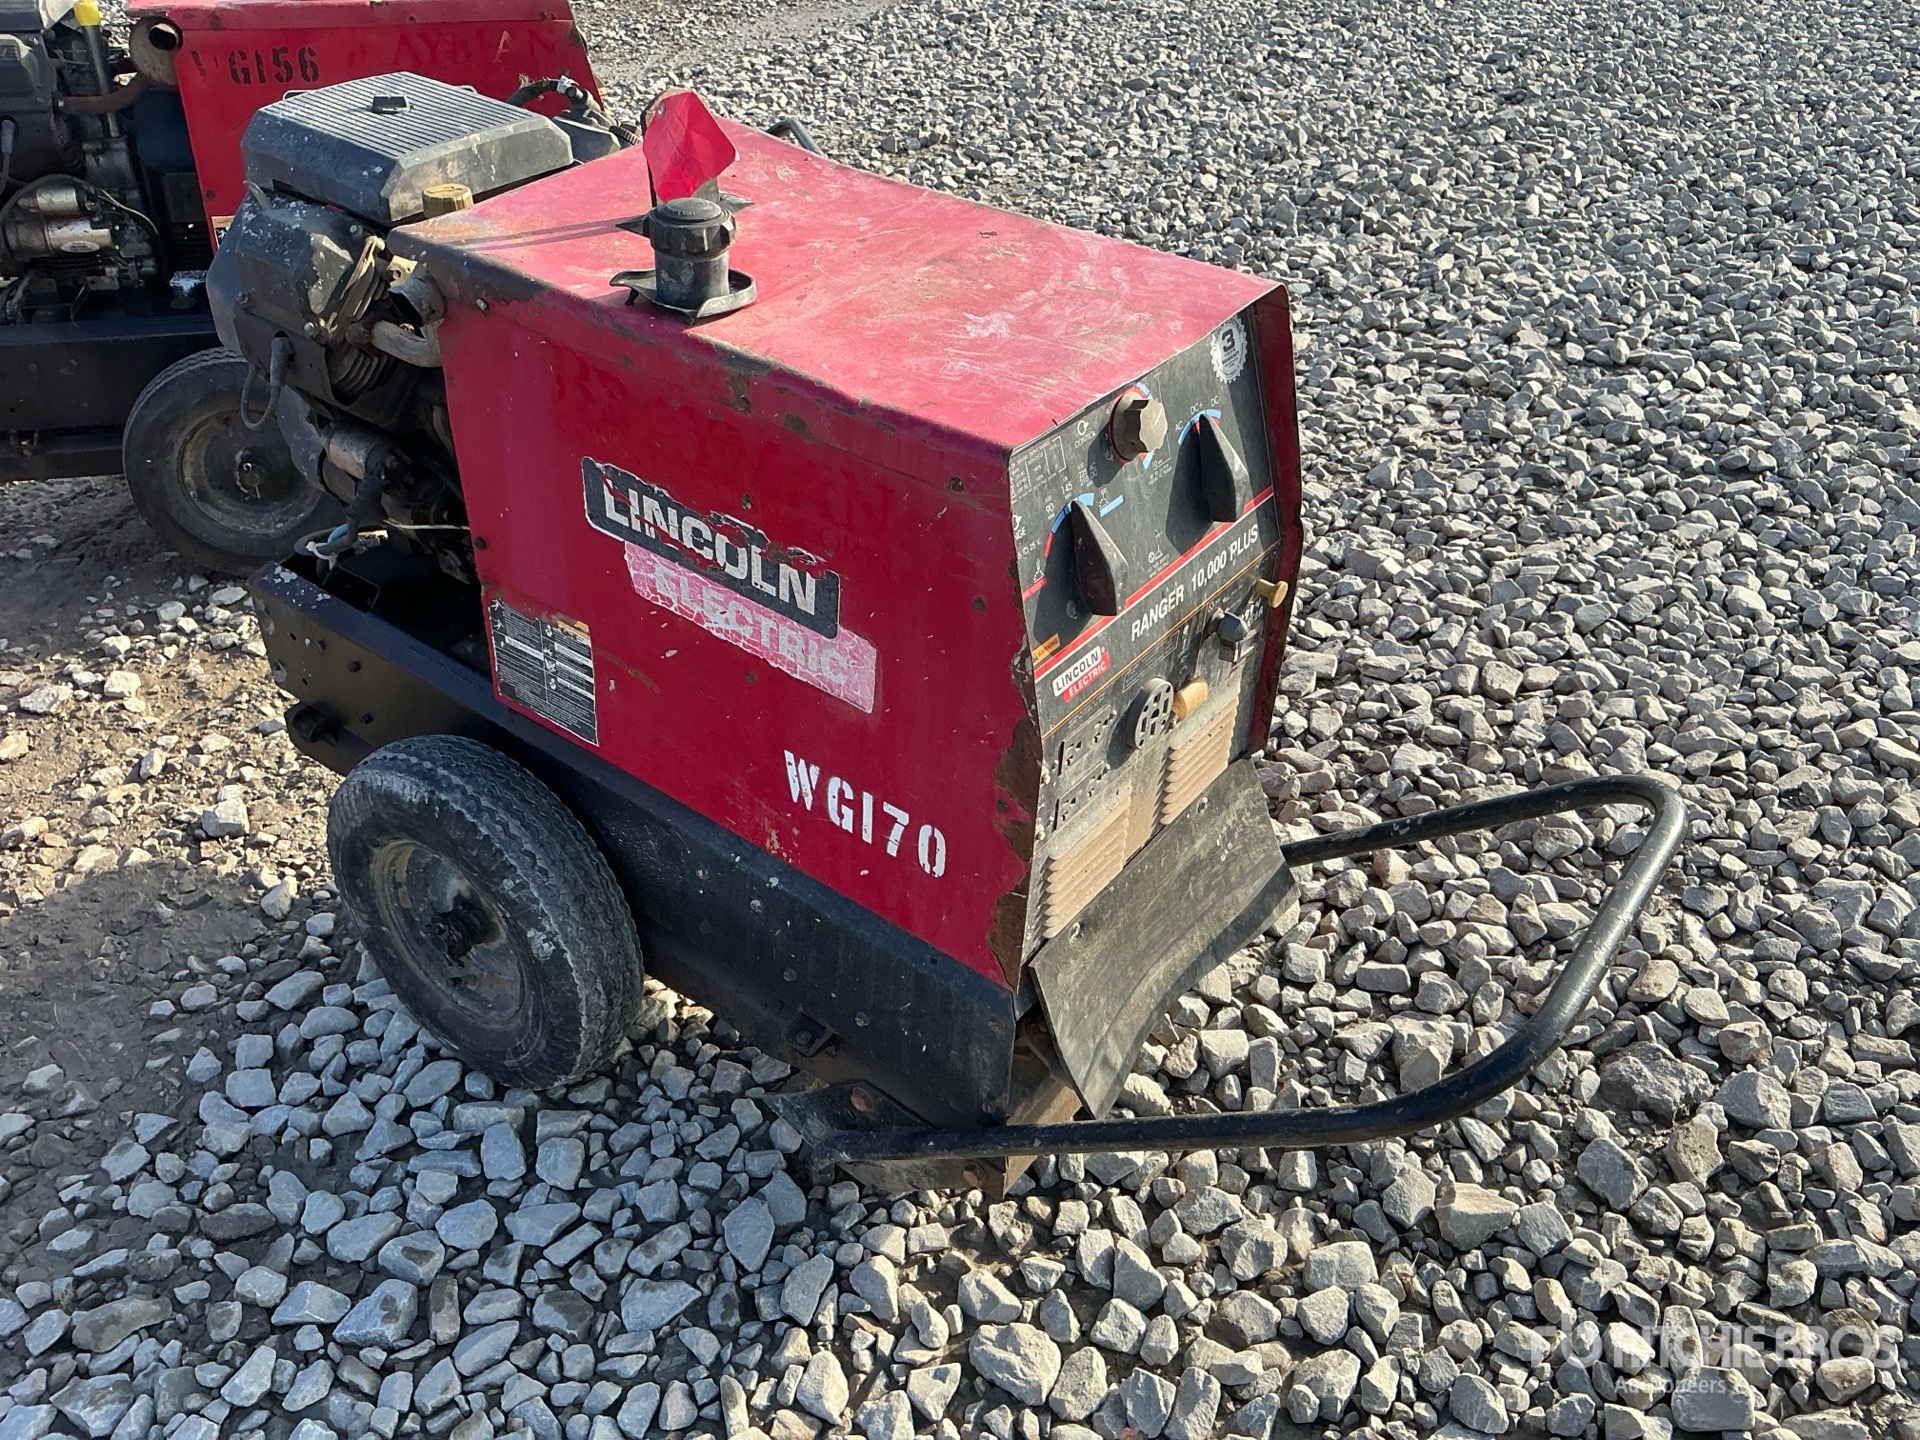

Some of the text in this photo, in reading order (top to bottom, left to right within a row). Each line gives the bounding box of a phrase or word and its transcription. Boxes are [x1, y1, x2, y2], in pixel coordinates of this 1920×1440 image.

[1221, 328, 1235, 353] 3
[603, 479, 817, 616] LINCOLN
[1045, 502, 1055, 514] 90
[1131, 583, 1185, 643] RANGER
[1191, 549, 1228, 592] 10,000
[1229, 523, 1259, 562] PLUS
[654, 565, 849, 685] ELECTRIC
[1055, 649, 1099, 692] LINCOLN
[1068, 660, 1107, 698] ELECTRIC
[783, 749, 947, 878] WG170
